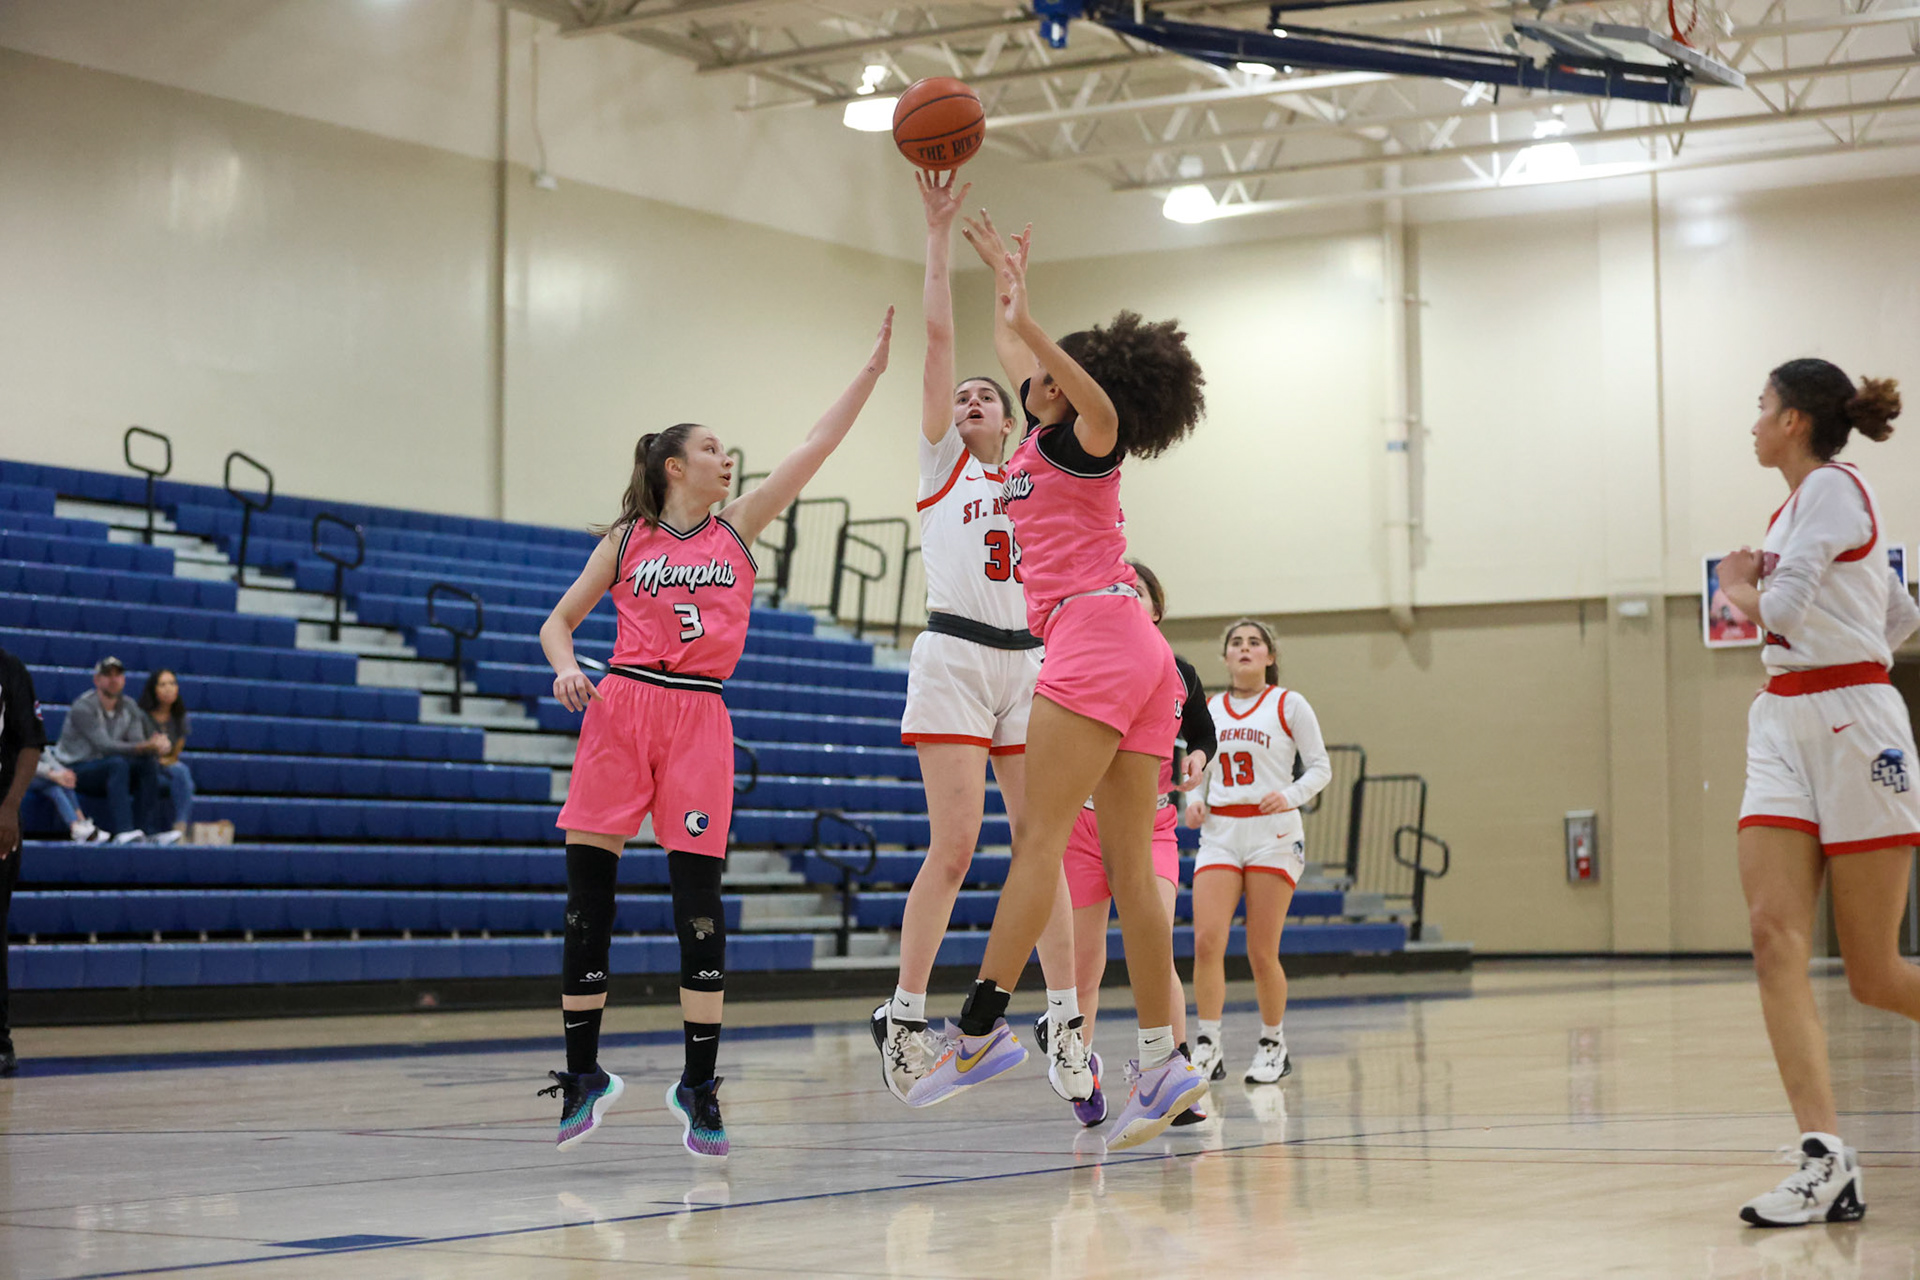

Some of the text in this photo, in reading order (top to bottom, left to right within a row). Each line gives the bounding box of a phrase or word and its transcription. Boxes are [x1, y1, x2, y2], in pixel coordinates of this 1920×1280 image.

[917, 131, 980, 161] THE ROCK
[963, 498, 988, 525] ST.
[626, 553, 737, 598] Memphis
[674, 603, 705, 643] 3
[1219, 728, 1272, 750] BENEDICT
[1219, 751, 1255, 788] 13
